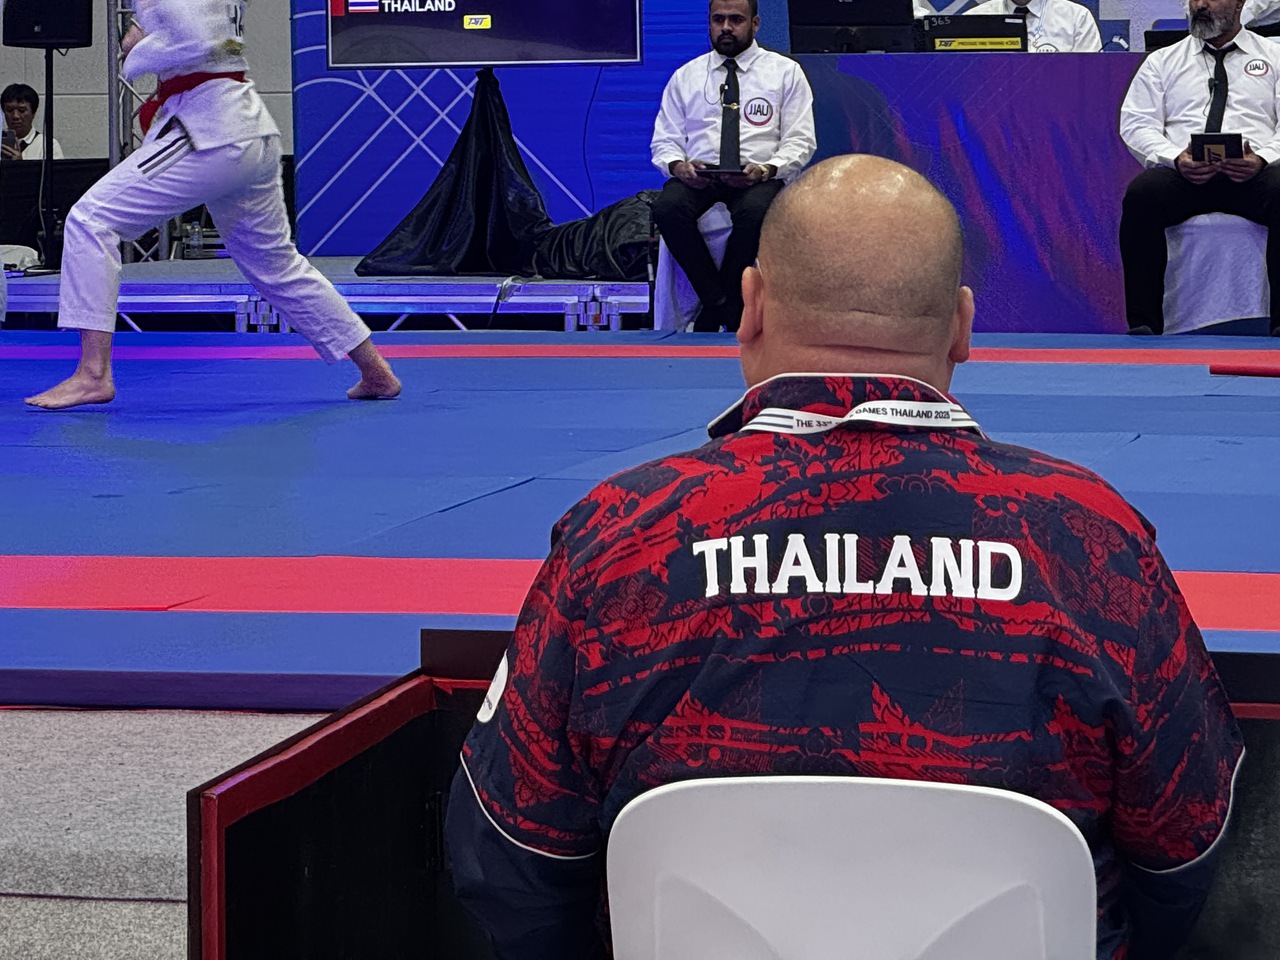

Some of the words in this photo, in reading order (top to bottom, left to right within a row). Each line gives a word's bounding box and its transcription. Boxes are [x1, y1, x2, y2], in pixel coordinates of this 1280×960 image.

[382, 0, 456, 13] THAILAND
[931, 16, 951, 26] 365
[796, 418, 814, 428] THE
[855, 406, 887, 416] GAMES
[890, 407, 933, 419] THAILAND
[934, 410, 951, 420] 2025
[692, 533, 1022, 601] THAILAND
